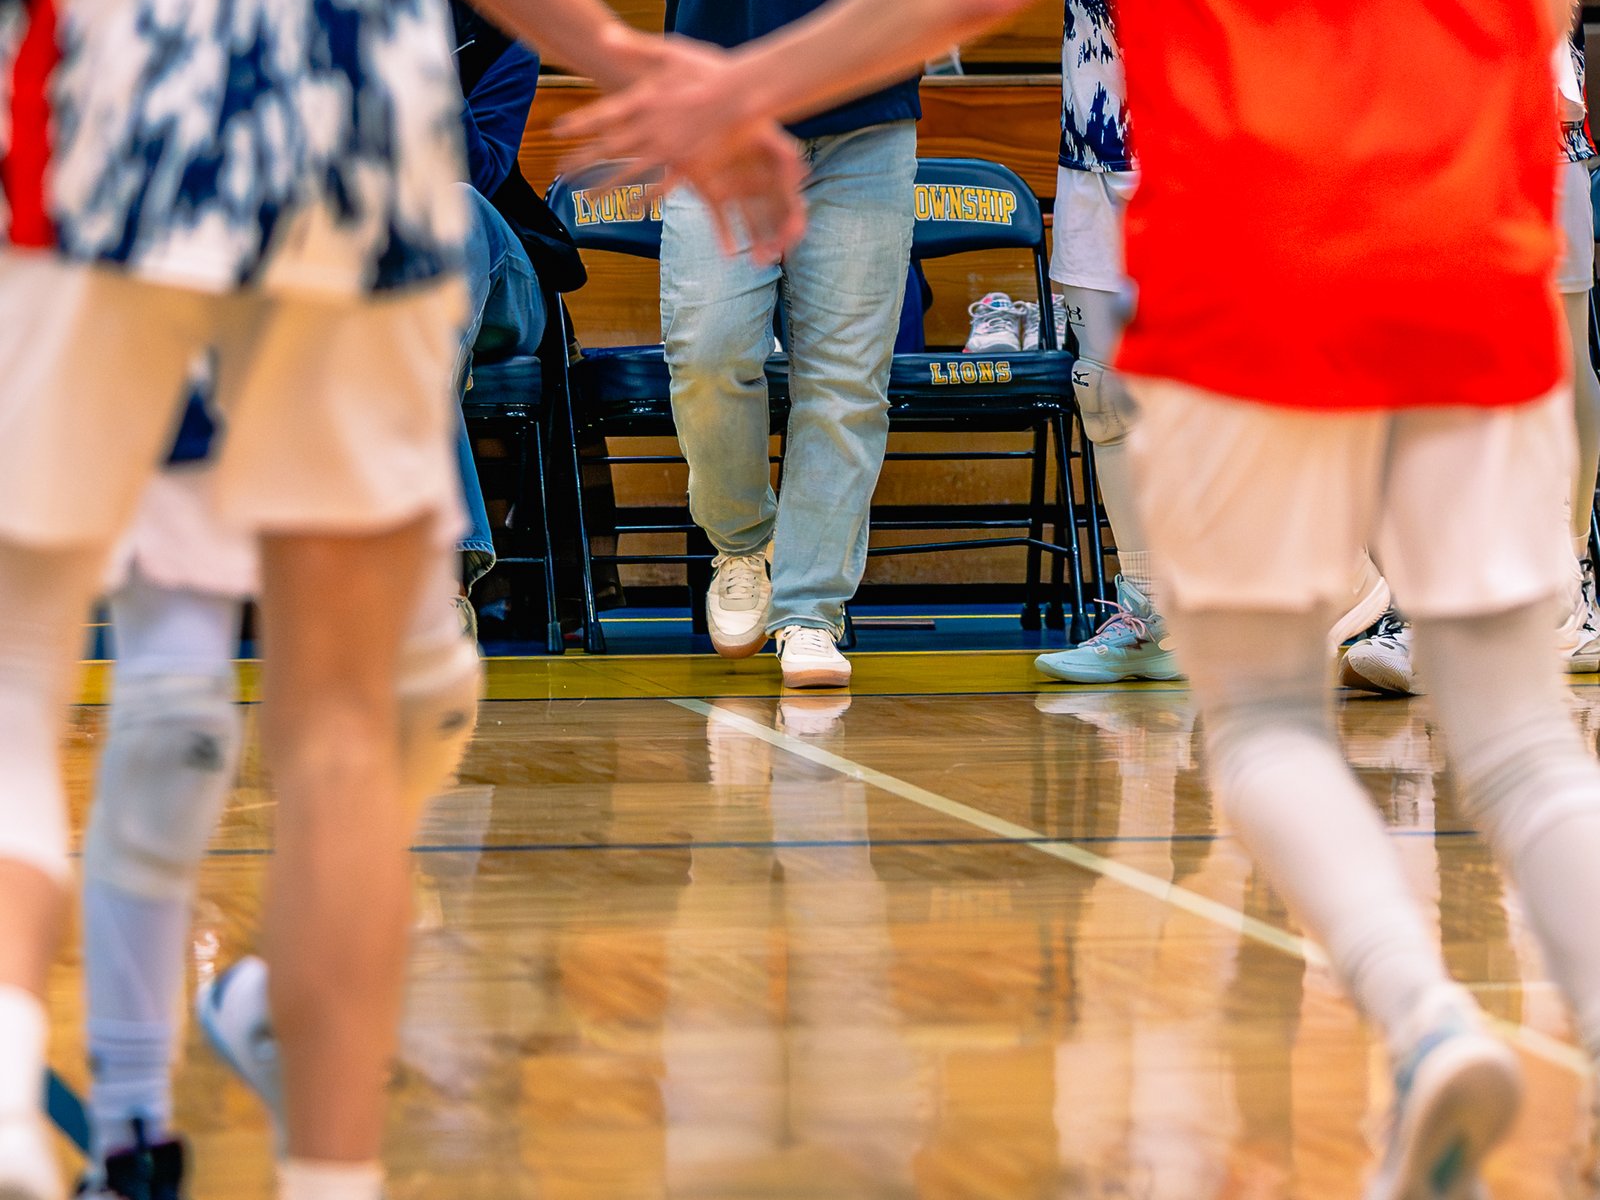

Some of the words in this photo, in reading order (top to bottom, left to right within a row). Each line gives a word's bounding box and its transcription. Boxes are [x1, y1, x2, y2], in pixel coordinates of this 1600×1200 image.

[572, 184, 646, 226] LYONS
[913, 184, 1017, 226] OWNSHIP
[930, 361, 1012, 384] LIONS
